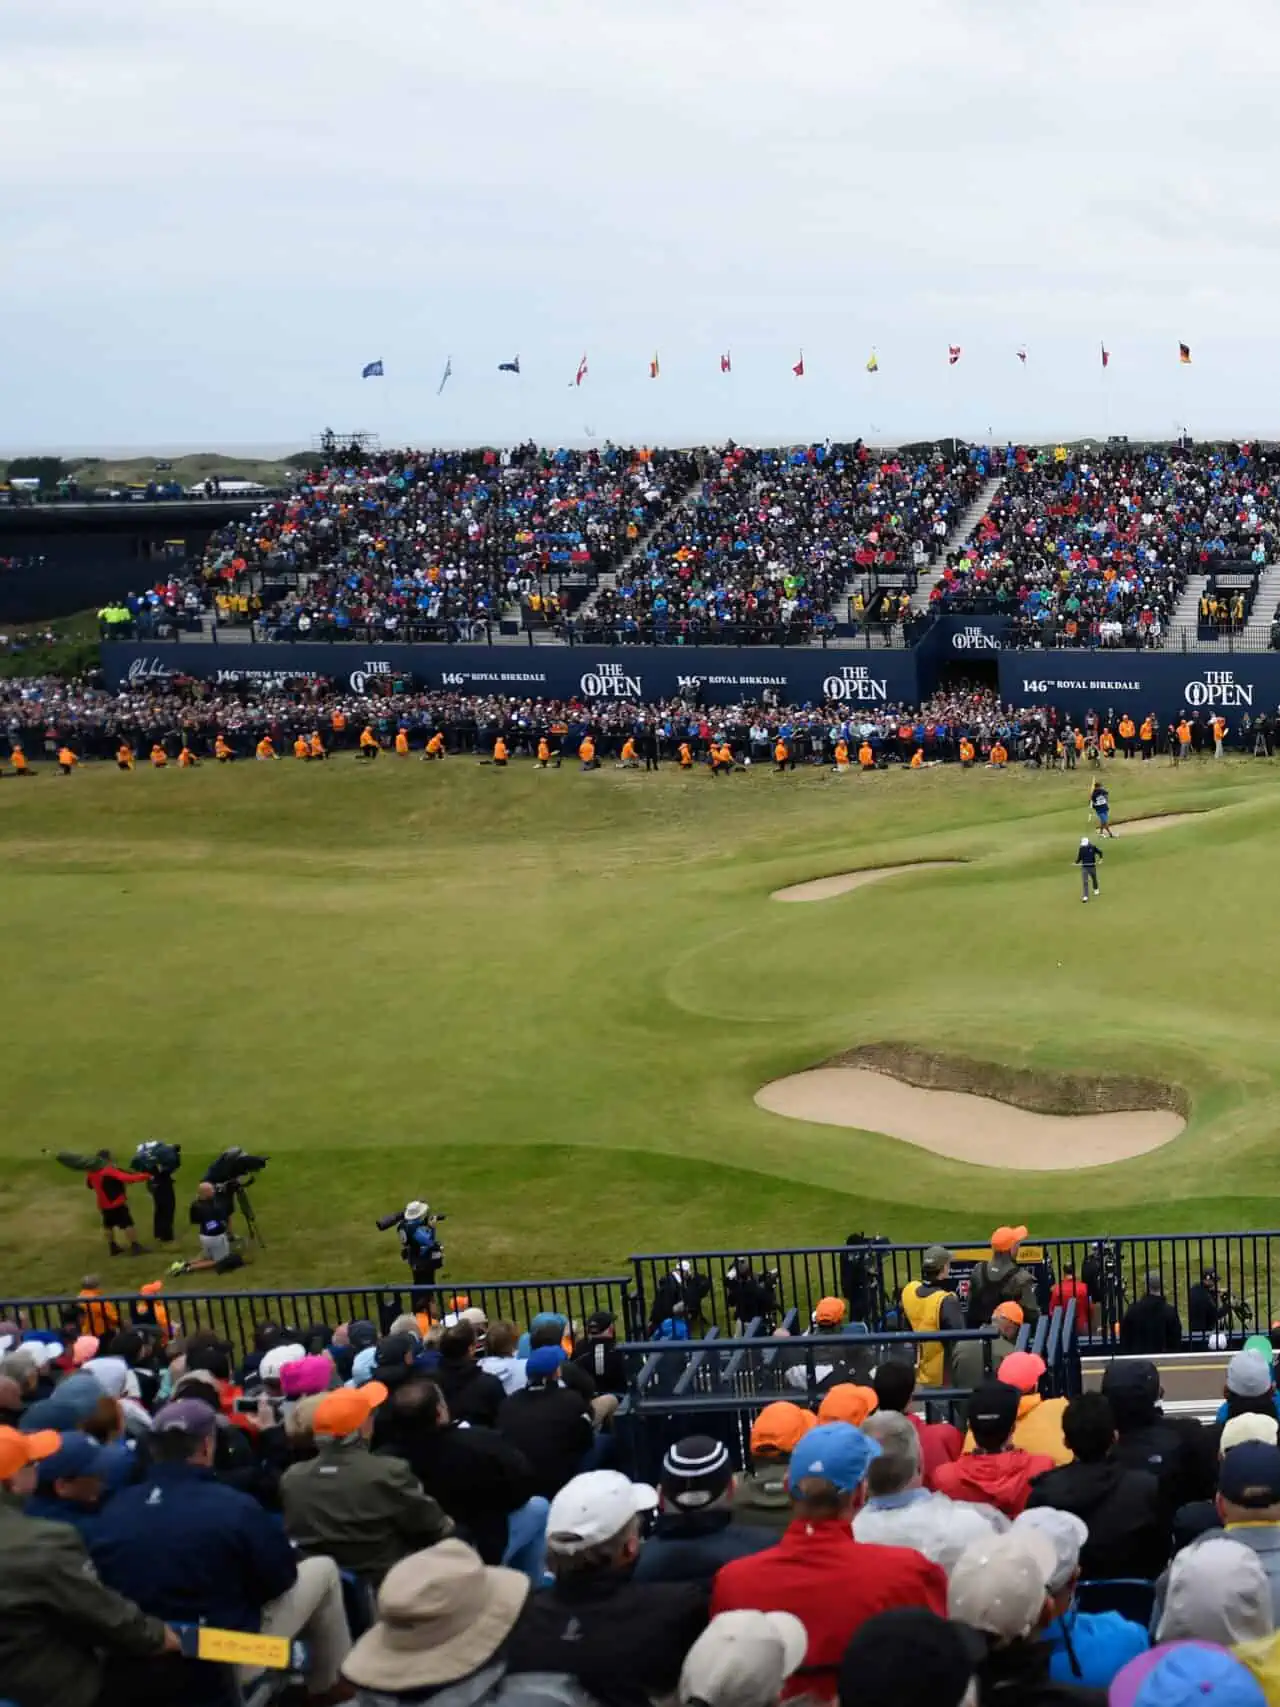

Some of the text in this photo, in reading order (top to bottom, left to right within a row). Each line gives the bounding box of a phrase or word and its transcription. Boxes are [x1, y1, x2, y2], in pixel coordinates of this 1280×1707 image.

[964, 626, 982, 635] THE
[952, 633, 994, 649] OPEN
[364, 661, 391, 673] THE
[596, 663, 624, 676] THE
[840, 666, 869, 679] THE
[471, 673, 499, 681] ROYAL
[500, 674, 546, 682] BIRKDALE
[708, 676, 738, 685] ROYAL
[740, 677, 787, 685] BIRKDALE
[1203, 671, 1234, 684] THE
[580, 672, 643, 697] OPEN
[823, 675, 888, 700] OPEN
[1057, 680, 1088, 689] ROYAL
[1090, 681, 1140, 690] BIRKDALE
[1184, 681, 1253, 706] OPEN
